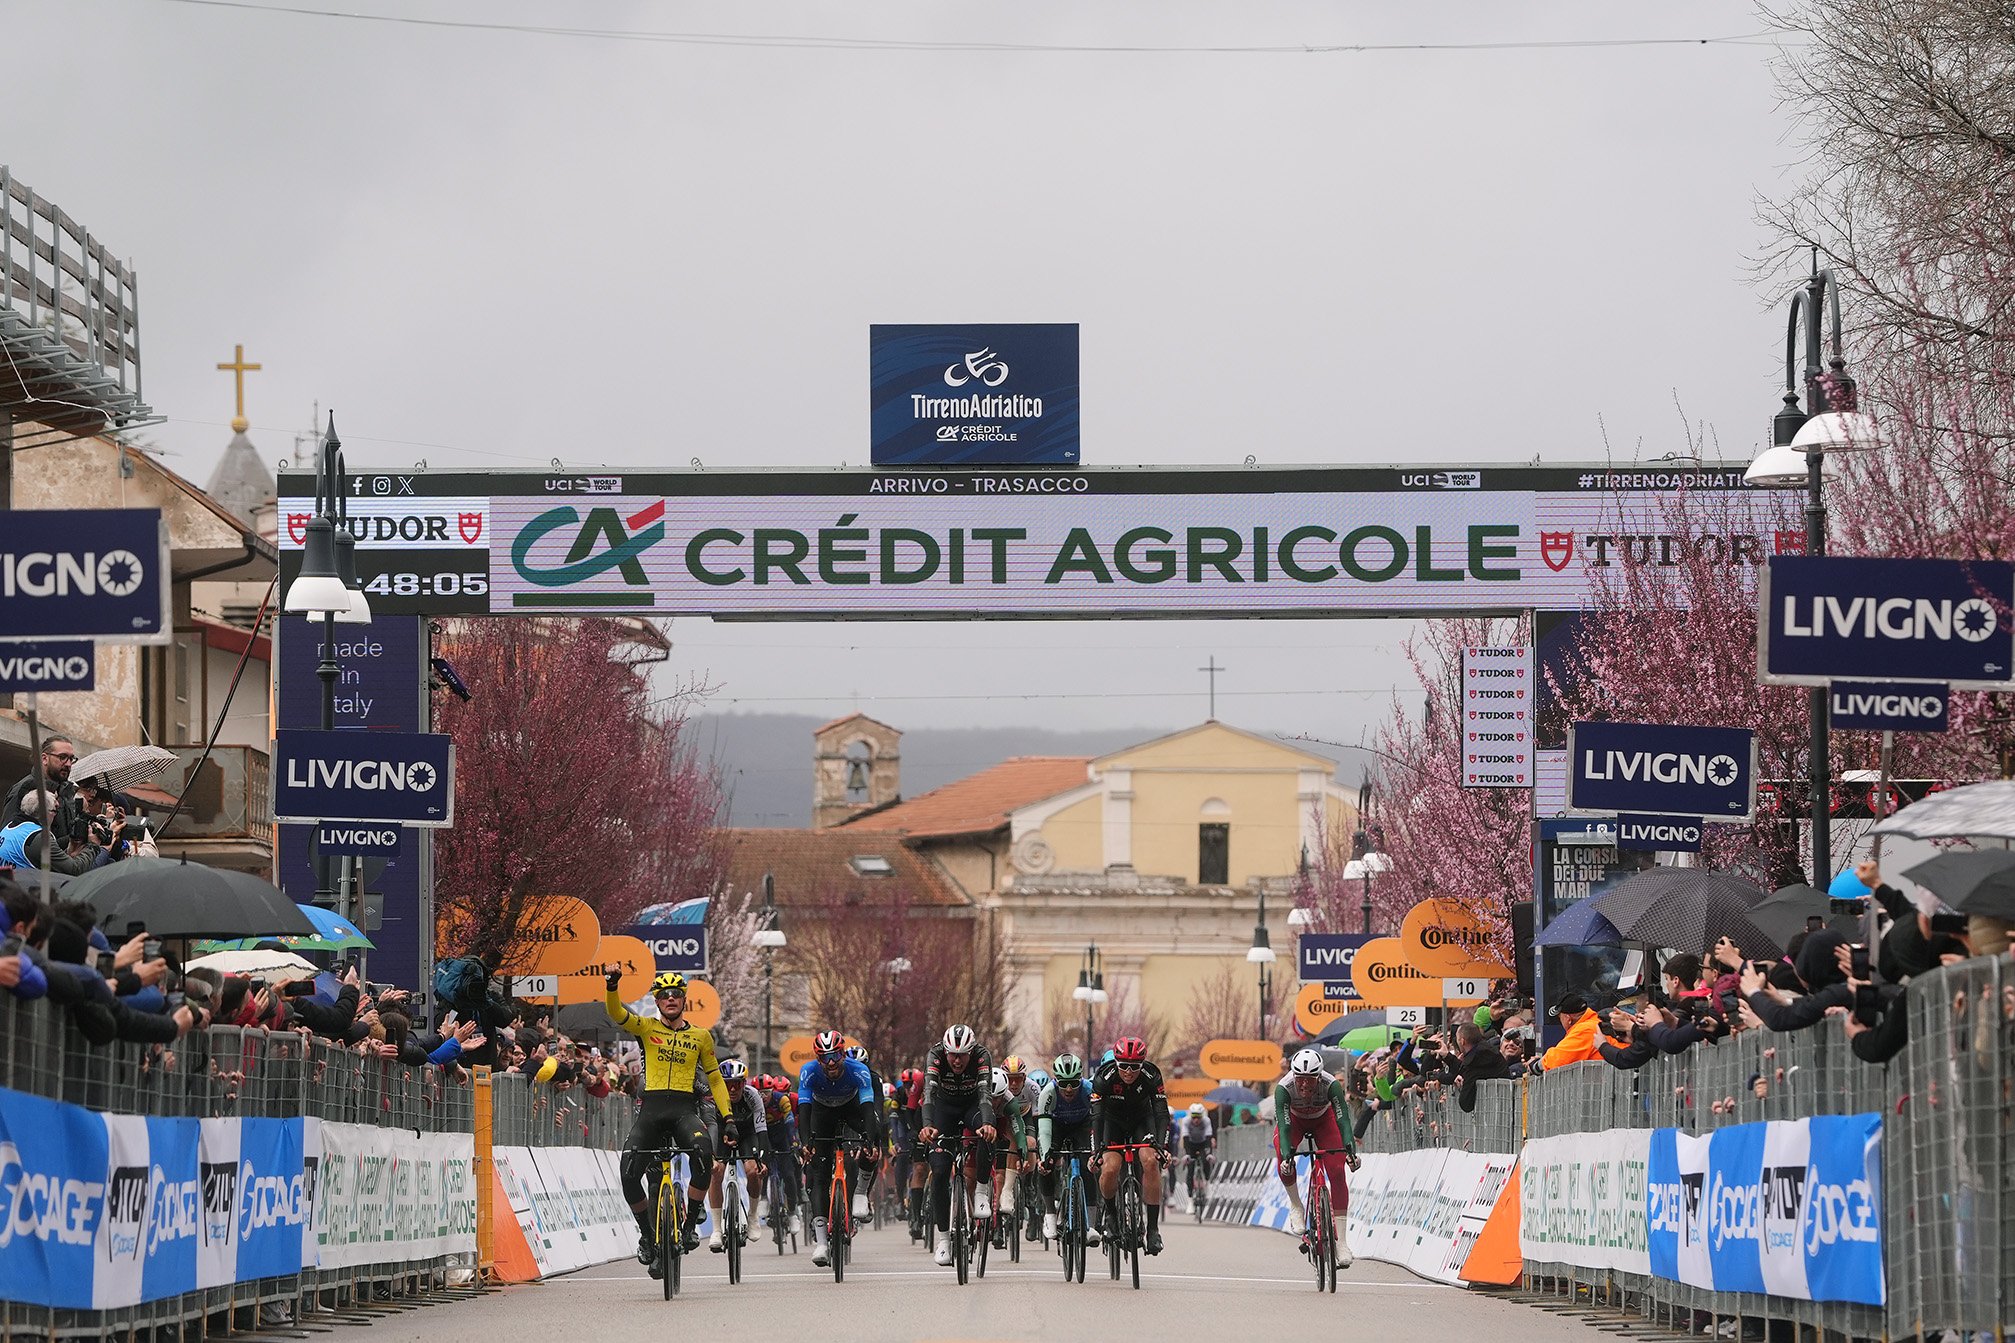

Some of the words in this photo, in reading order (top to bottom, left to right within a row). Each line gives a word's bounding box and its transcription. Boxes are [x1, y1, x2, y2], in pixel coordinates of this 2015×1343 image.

[911, 394, 1043, 418] TirrenoAdriatico
[961, 424, 1001, 433] CRÉDIT
[961, 433, 1017, 441] AGRICOLE
[545, 479, 572, 491] UCI
[869, 478, 948, 492] ARRIVO
[972, 478, 1089, 493] TRASACCO
[1402, 475, 1430, 486] UCI
[1578, 473, 1753, 488] #TIRRENOADRIATIC
[346, 516, 449, 542] UDOR
[685, 513, 1026, 586] CRÉDIT
[1044, 524, 1521, 585] AGRICOLE
[0, 550, 144, 597] IGNO
[1784, 595, 1998, 642] LIVIGNO
[1478, 649, 1515, 658] TUDOR
[341, 665, 360, 684] in
[1478, 669, 1515, 678] TUDOR
[1478, 690, 1515, 699] TUDOR
[333, 692, 373, 719] taly
[1833, 694, 1943, 718] LIVIGNO
[1478, 711, 1515, 720] TUDOR
[1478, 733, 1515, 742] TUDOR
[1478, 755, 1515, 763] TUDOR
[288, 759, 436, 792] LIVIGNO
[1585, 750, 1738, 786] LIVIGNO
[1478, 774, 1515, 783] TUDOR
[320, 829, 397, 846] LIVIGNO
[1621, 824, 1699, 842] LIVIGNO
[1553, 847, 1569, 864] LA
[1574, 847, 1619, 864] CORSA
[1579, 865, 1605, 881] DUE
[1554, 882, 1591, 898] MARI
[1306, 948, 1356, 965] LIVIG
[527, 978, 546, 993] 10
[1324, 986, 1357, 996] LIVIGN
[1457, 981, 1475, 995] 10
[1401, 1010, 1417, 1022] 25
[667, 1039, 697, 1051] VISMA
